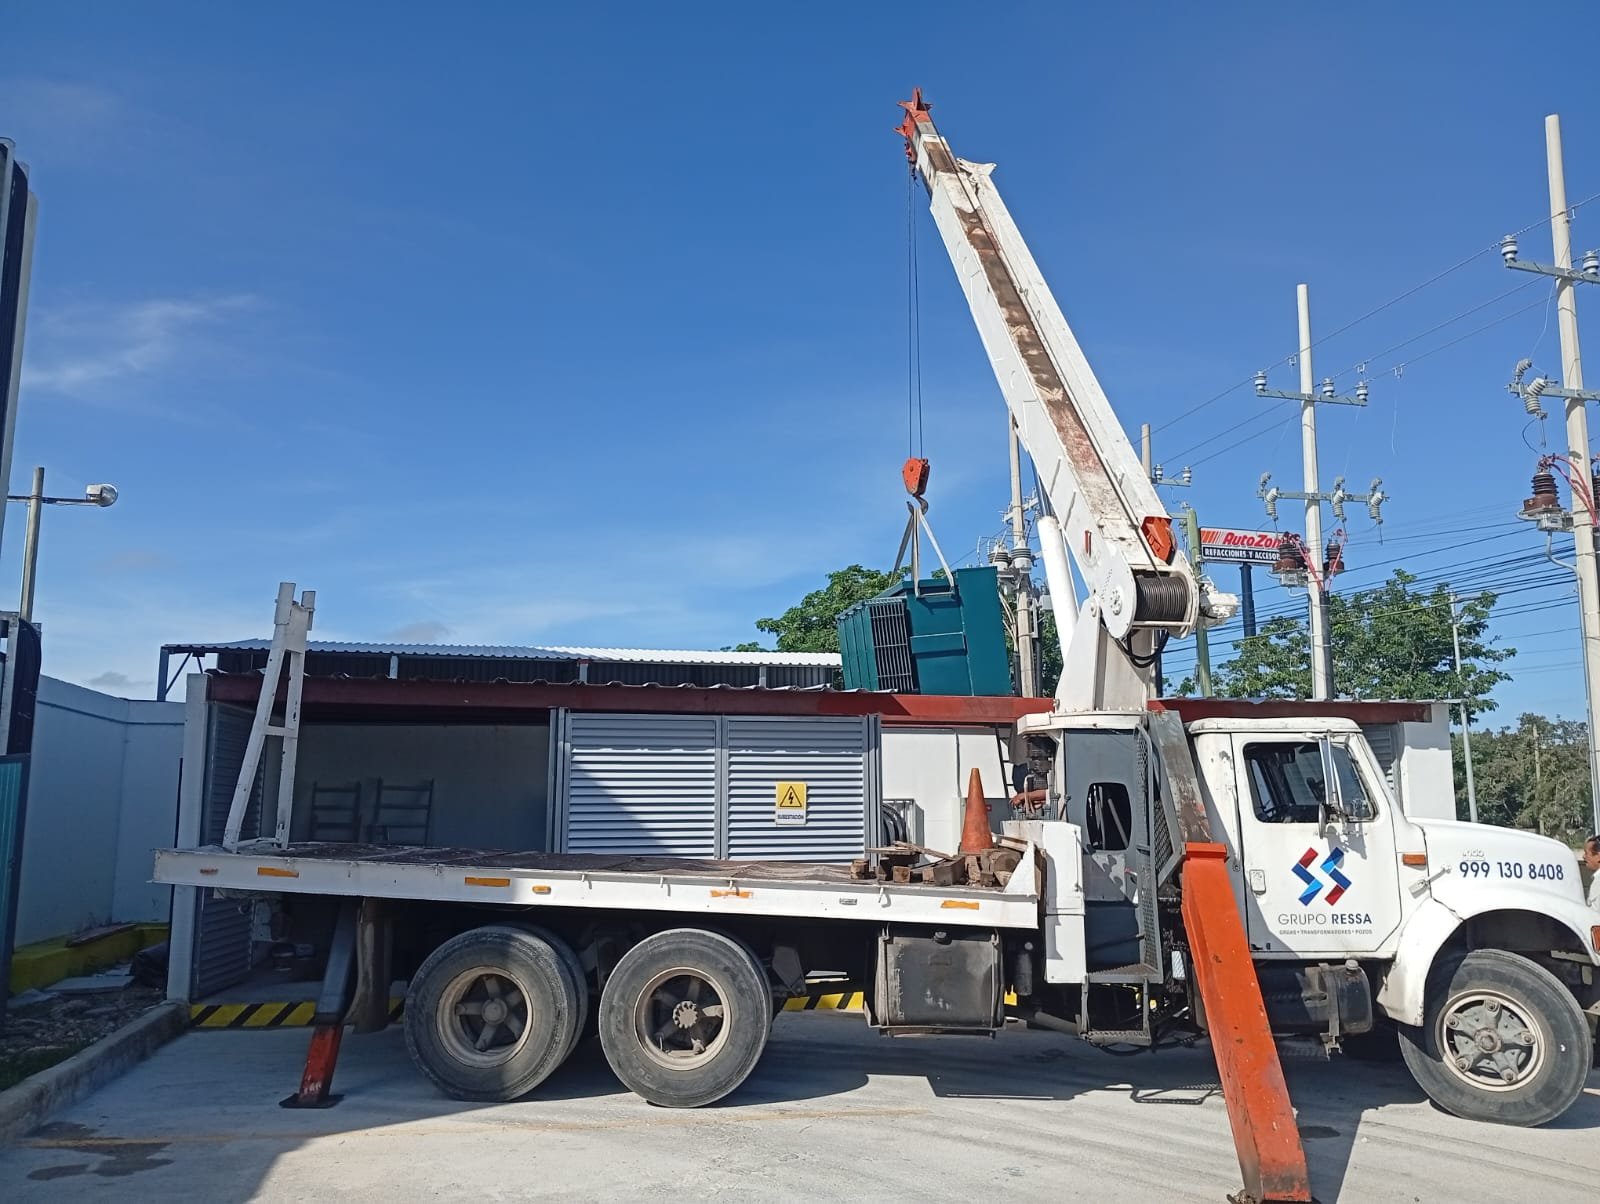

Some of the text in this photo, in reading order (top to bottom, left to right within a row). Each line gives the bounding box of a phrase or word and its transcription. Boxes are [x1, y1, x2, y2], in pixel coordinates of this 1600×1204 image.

[1222, 532, 1281, 548] AutoZon
[1204, 548, 1281, 561] REFACCIONES Y ACCESOR
[1459, 861, 1564, 881] 999 130 8408
[1278, 913, 1372, 925] GRUPO RESSA
